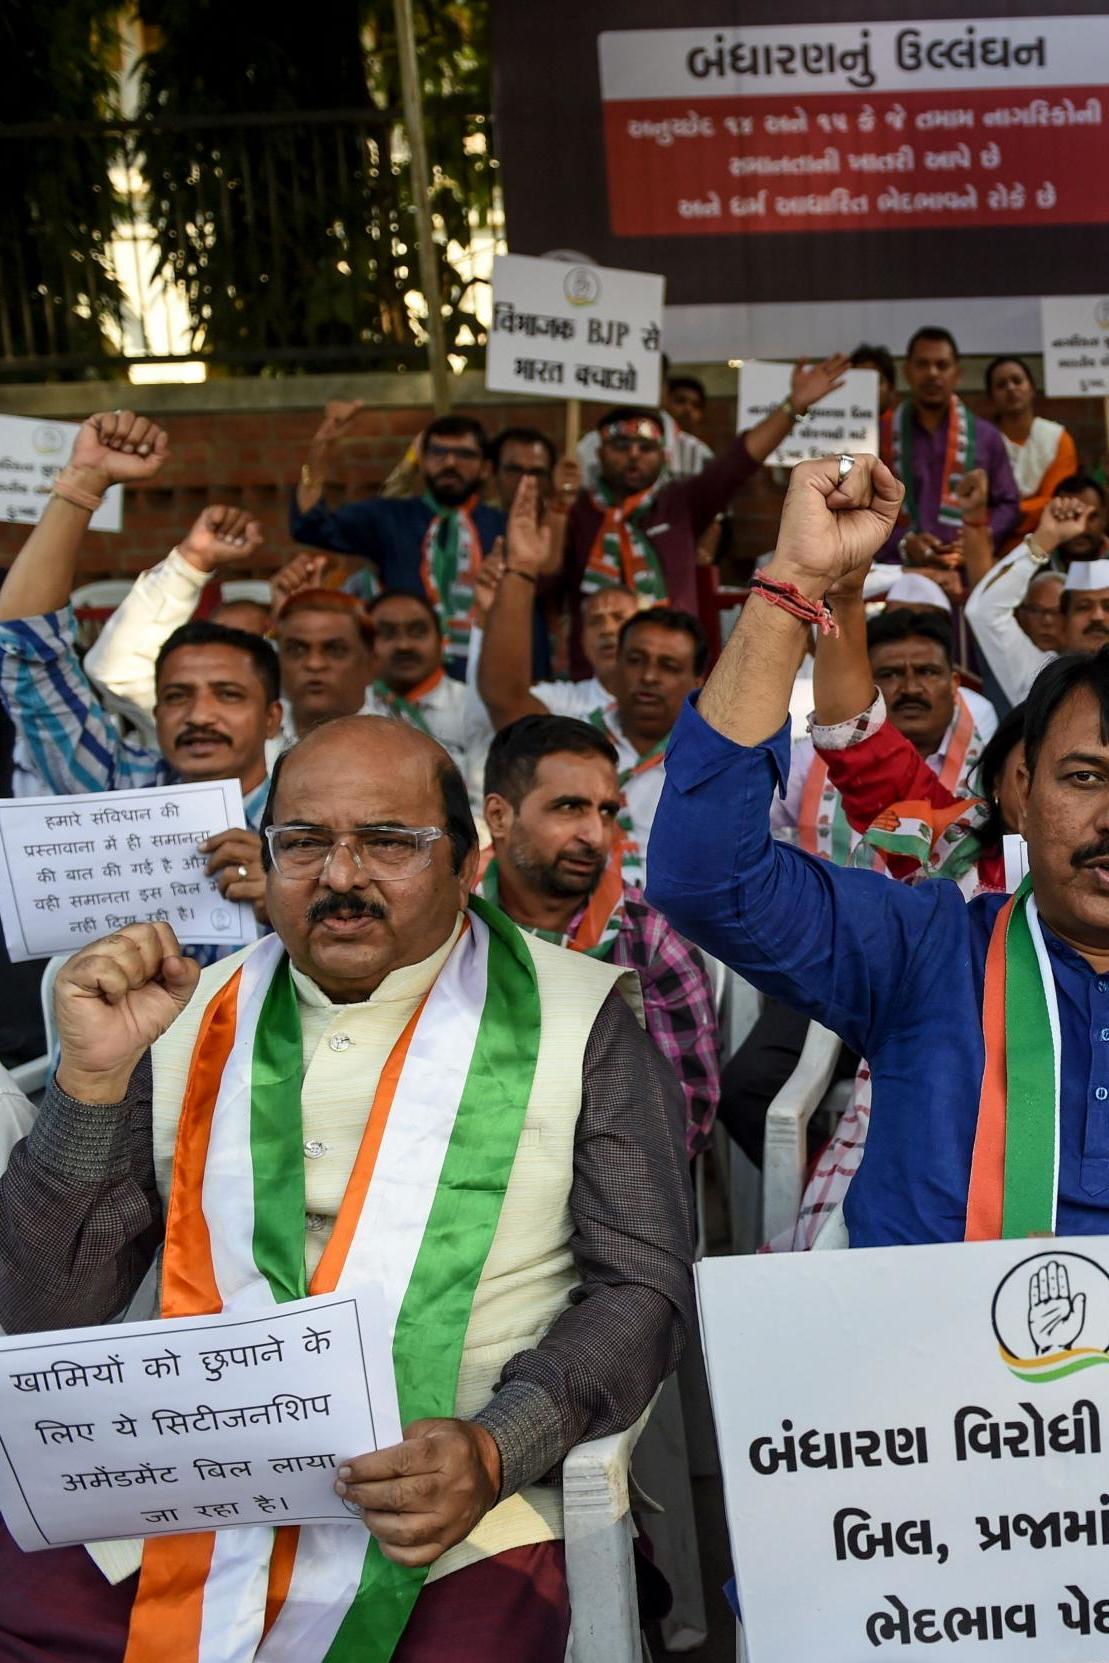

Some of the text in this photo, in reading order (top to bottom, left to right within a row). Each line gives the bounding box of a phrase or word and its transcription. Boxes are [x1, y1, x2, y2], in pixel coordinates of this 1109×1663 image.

[687, 26, 1046, 88] બંધારણનું ઉલ્લંઘન
[764, 106, 808, 134] અને
[678, 190, 721, 219] અને
[587, 317, 630, 347] BJP
[641, 320, 661, 351] से
[514, 357, 638, 391] भारत बचाओ
[45, 811, 82, 830] हमारे
[160, 802, 180, 819] की
[104, 834, 117, 851] में
[126, 833, 141, 851] ही
[150, 830, 211, 847] समानता
[36, 867, 56, 883] की
[64, 868, 93, 881] बात
[102, 862, 122, 878] की
[130, 858, 153, 875] गई
[160, 857, 173, 874] है
[68, 890, 130, 908] समानता
[138, 886, 162, 903] इस
[169, 881, 200, 897] बिल
[9, 1326, 333, 1394] खामियों को छुपाने के
[35, 1393, 333, 1446] लिए ये सिटीजनशिप
[749, 1419, 929, 1475] બંધારણ
[953, 1399, 1102, 1461] વિરોધી
[61, 1452, 336, 1493] अमेंडमेंट बिल लाया
[141, 1507, 179, 1524] जा
[197, 1502, 240, 1519] रहा
[832, 1507, 949, 1565] બિલ,
[865, 1594, 1037, 1647] ભેદભાવ
